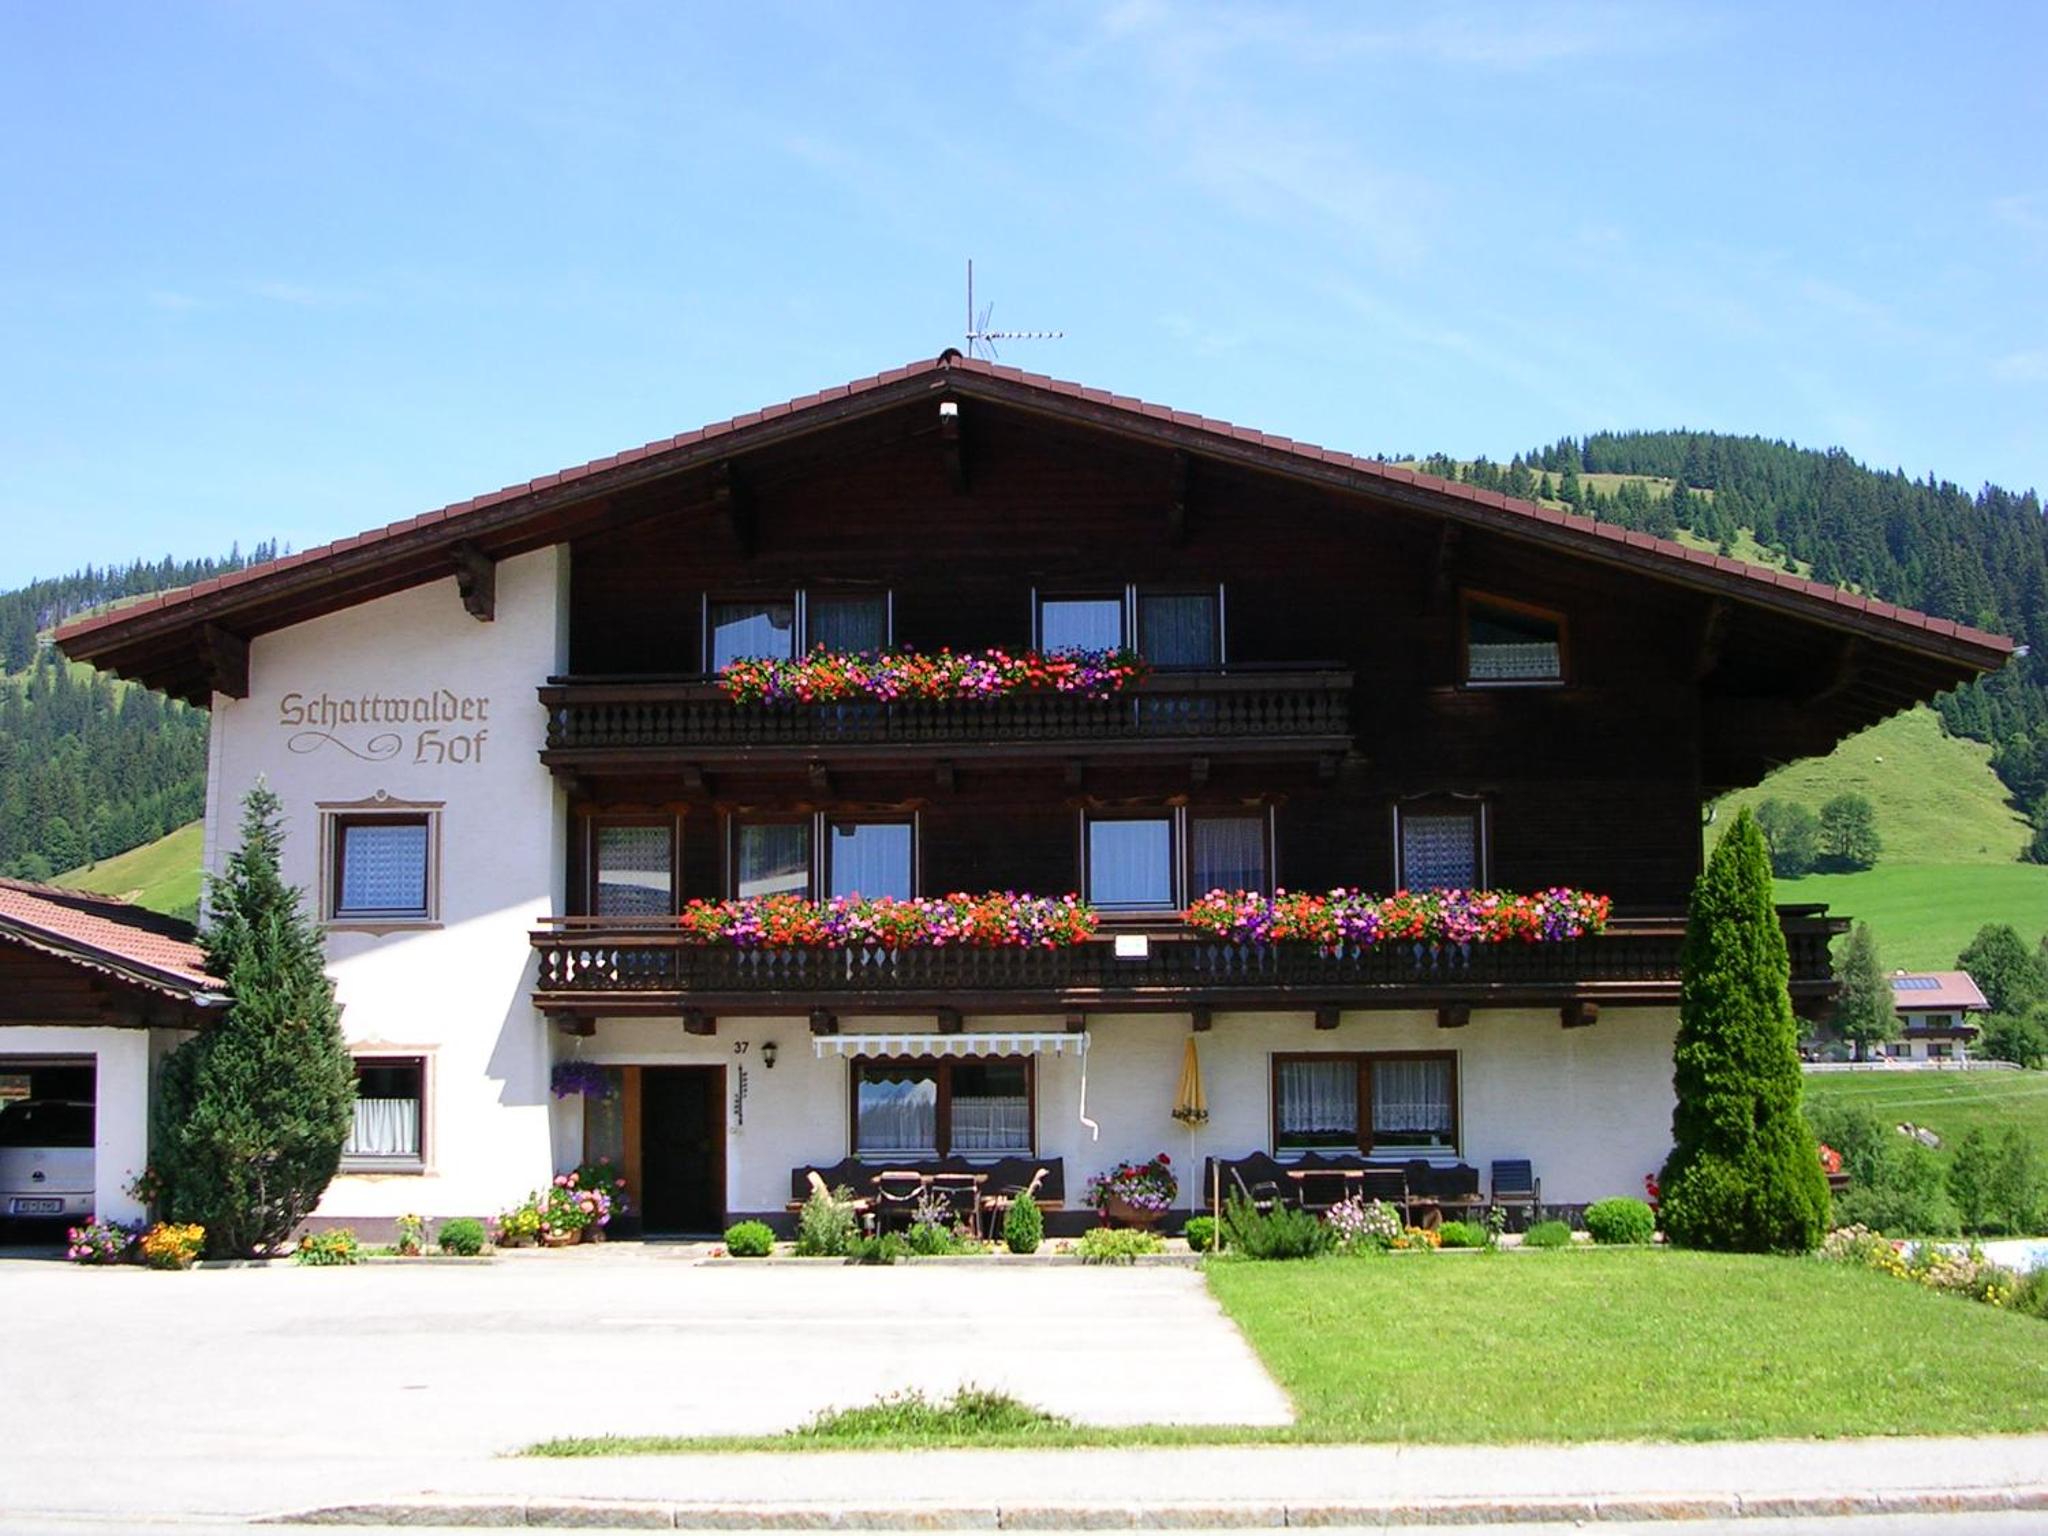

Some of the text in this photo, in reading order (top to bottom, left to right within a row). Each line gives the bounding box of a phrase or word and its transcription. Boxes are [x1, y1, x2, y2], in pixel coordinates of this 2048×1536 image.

[280, 690, 490, 728] Schattwalder
[413, 729, 488, 764] Hof
[734, 1041, 749, 1054] 37
